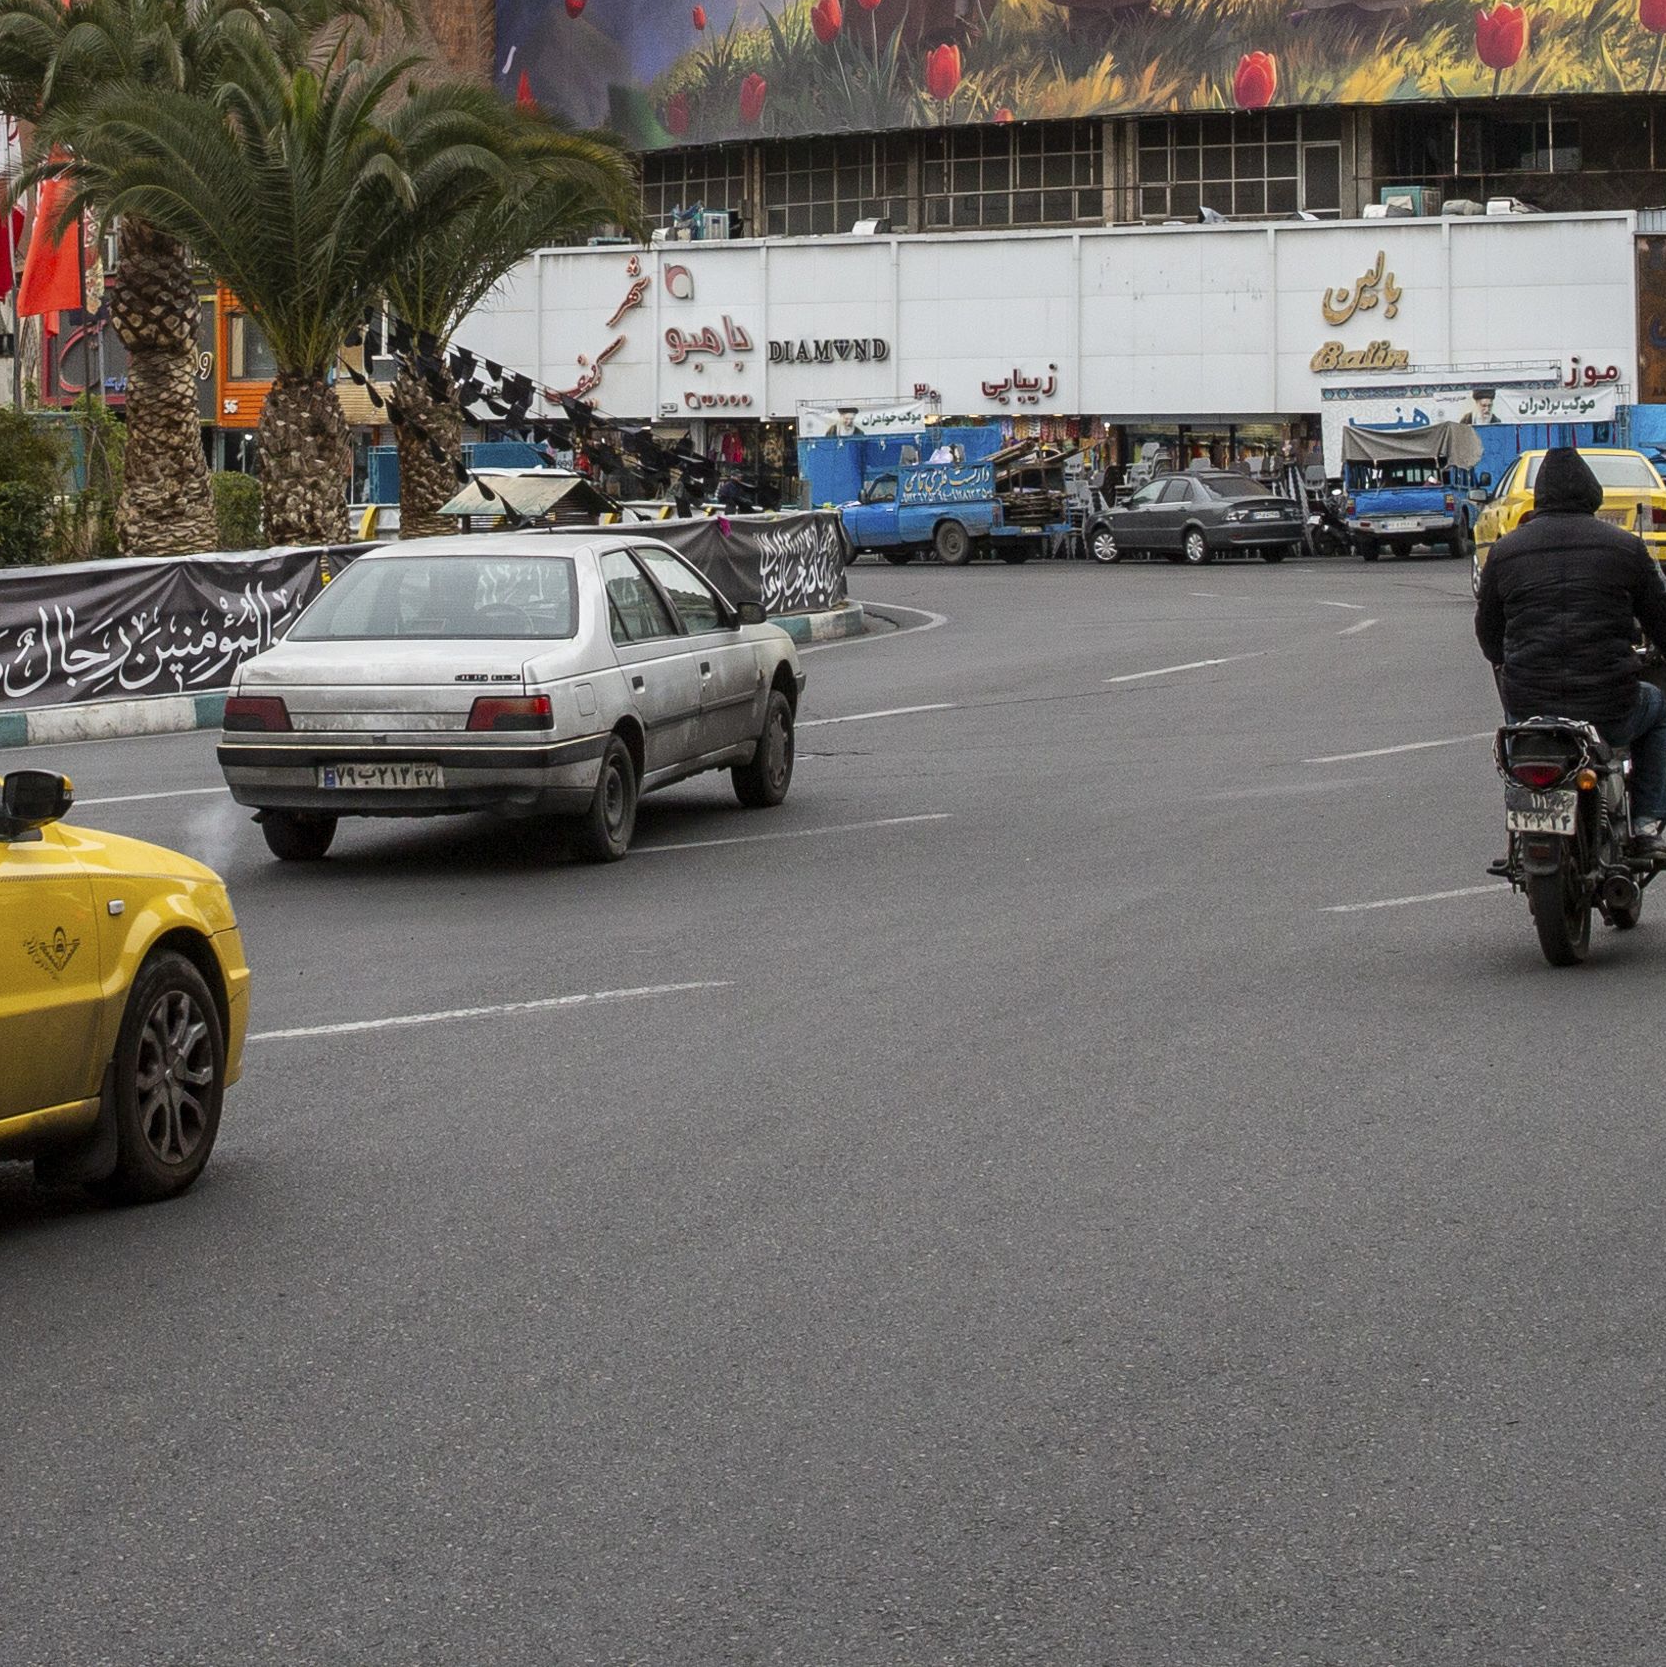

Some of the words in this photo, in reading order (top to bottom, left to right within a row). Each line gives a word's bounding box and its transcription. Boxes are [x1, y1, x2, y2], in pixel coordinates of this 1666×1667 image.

[1322, 250, 1402, 326] بالین
[664, 314, 755, 374] بامبو
[1310, 340, 1409, 373] Balin
[981, 362, 1058, 405] زیبایی
[1563, 355, 1621, 388] موز
[862, 412, 897, 426] خواهران
[897, 411, 922, 425] موکب
[1518, 397, 1561, 415] برادران
[1561, 396, 1596, 415] موکب
